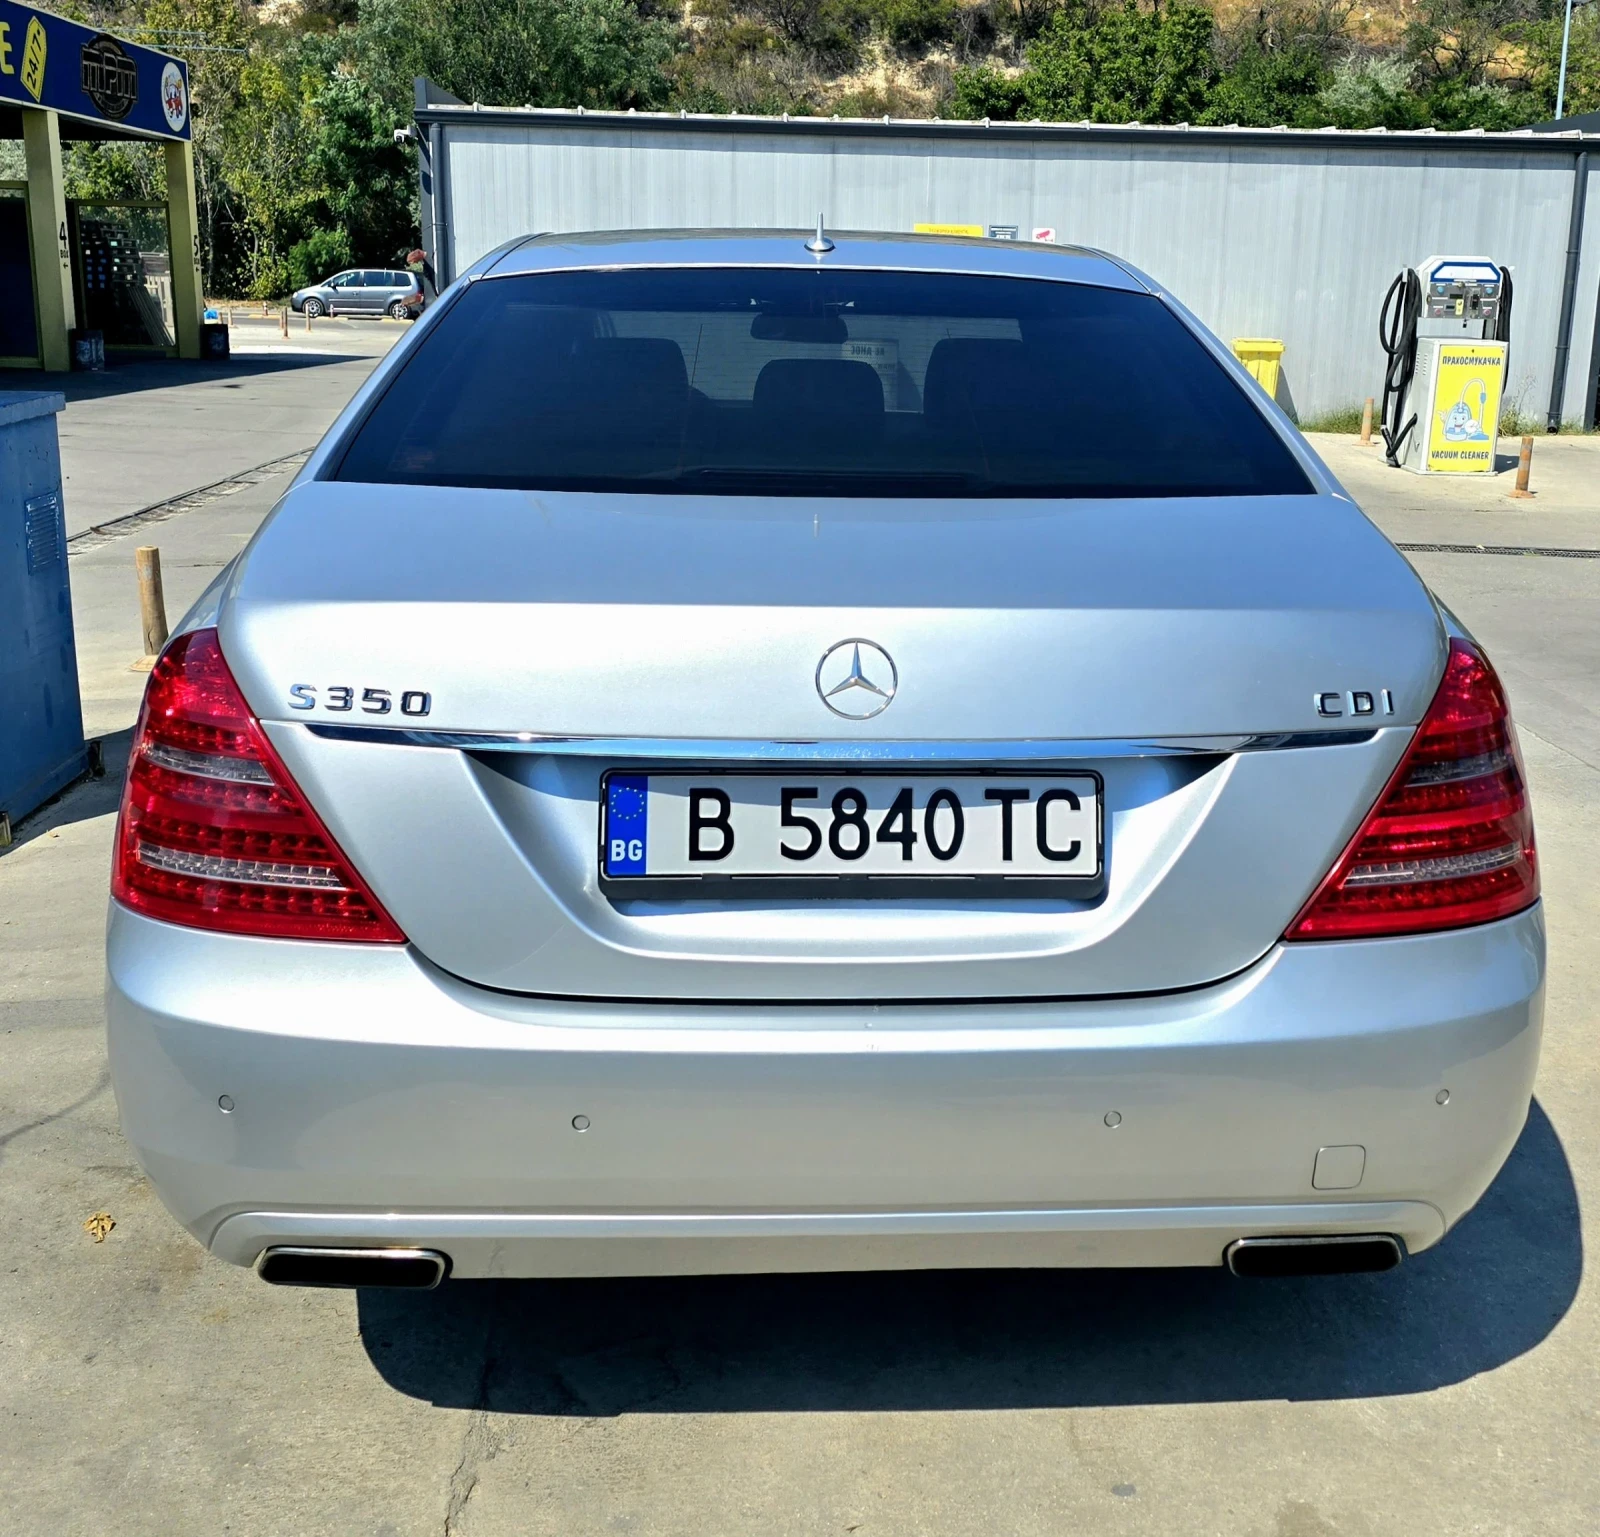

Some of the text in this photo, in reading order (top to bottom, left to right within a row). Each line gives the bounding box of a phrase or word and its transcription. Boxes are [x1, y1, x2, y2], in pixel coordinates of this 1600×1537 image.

[59, 221, 67, 249] 4
[193, 235, 199, 257] 5
[1442, 356, 1501, 366] ПРАХОСМУКАЧКА
[1431, 450, 1490, 460] VACUUM CLEANER
[1313, 688, 1395, 718] CDI
[688, 787, 1082, 862] B 5840 TC
[610, 838, 643, 862] BG
